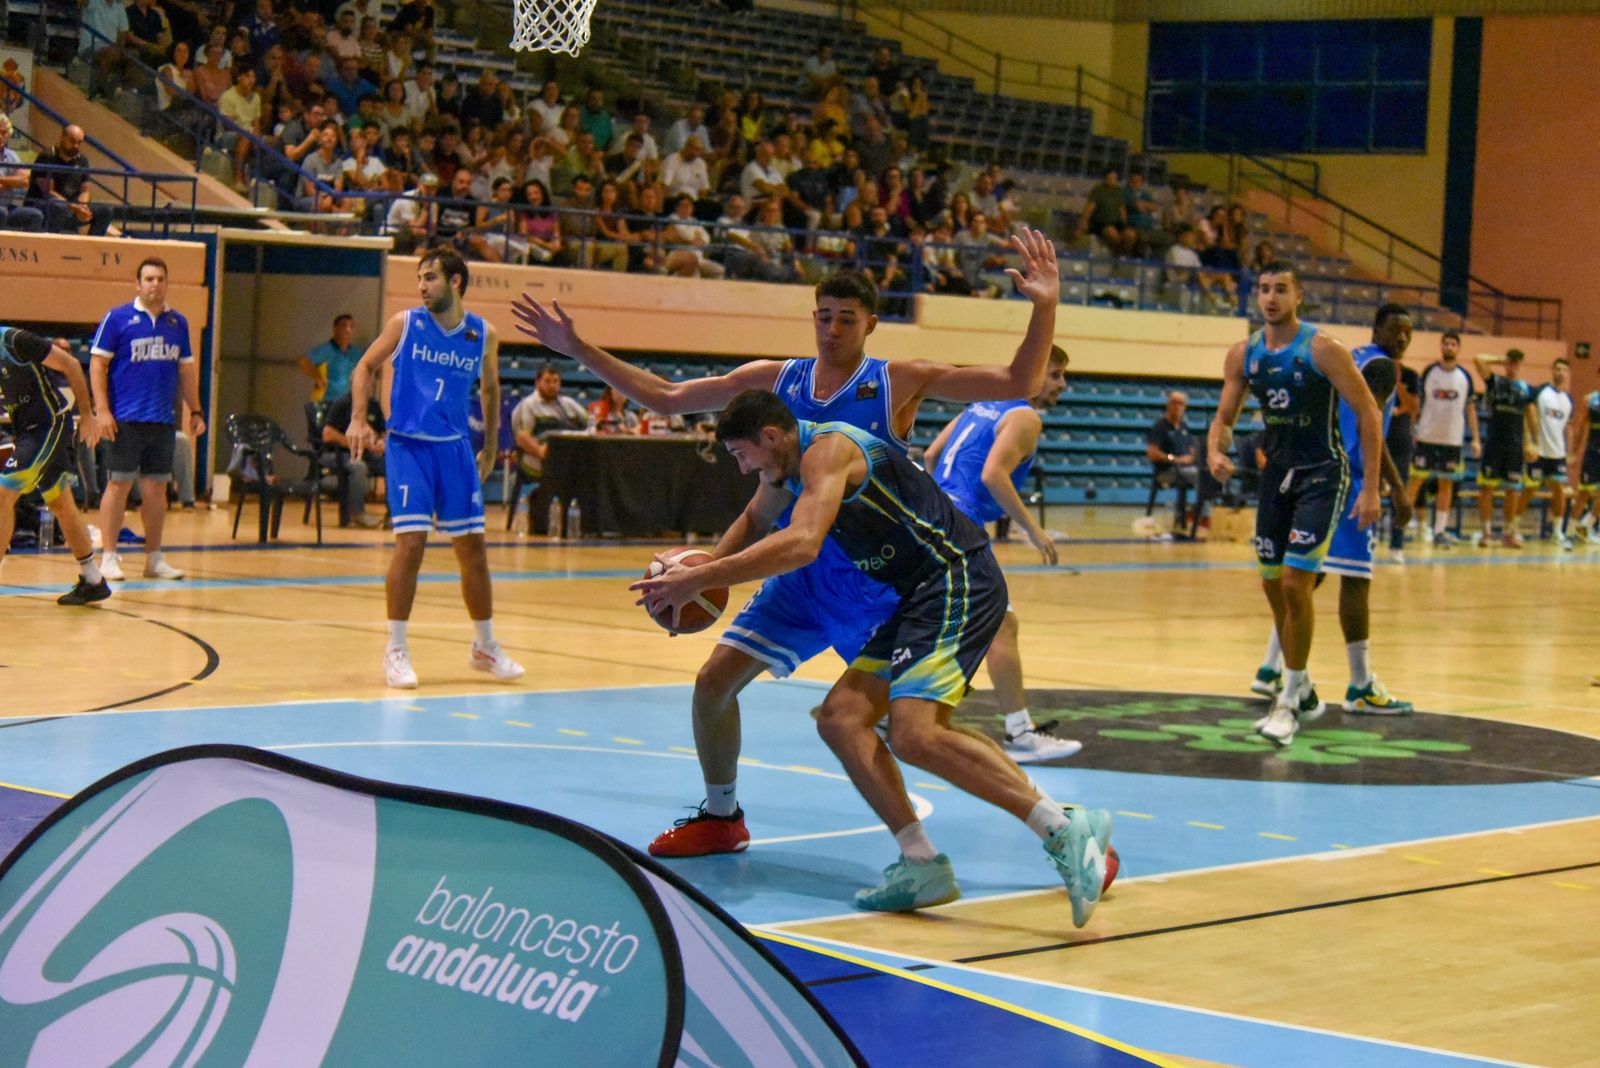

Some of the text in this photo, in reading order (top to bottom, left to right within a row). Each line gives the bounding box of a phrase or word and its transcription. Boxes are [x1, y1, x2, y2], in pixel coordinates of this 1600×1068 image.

[101, 252, 122, 266] TV
[434, 378, 445, 401] 7
[1266, 388, 1290, 409] 29
[399, 485, 409, 508] 7
[1255, 536, 1275, 559] 29
[416, 876, 638, 974] baloncesto
